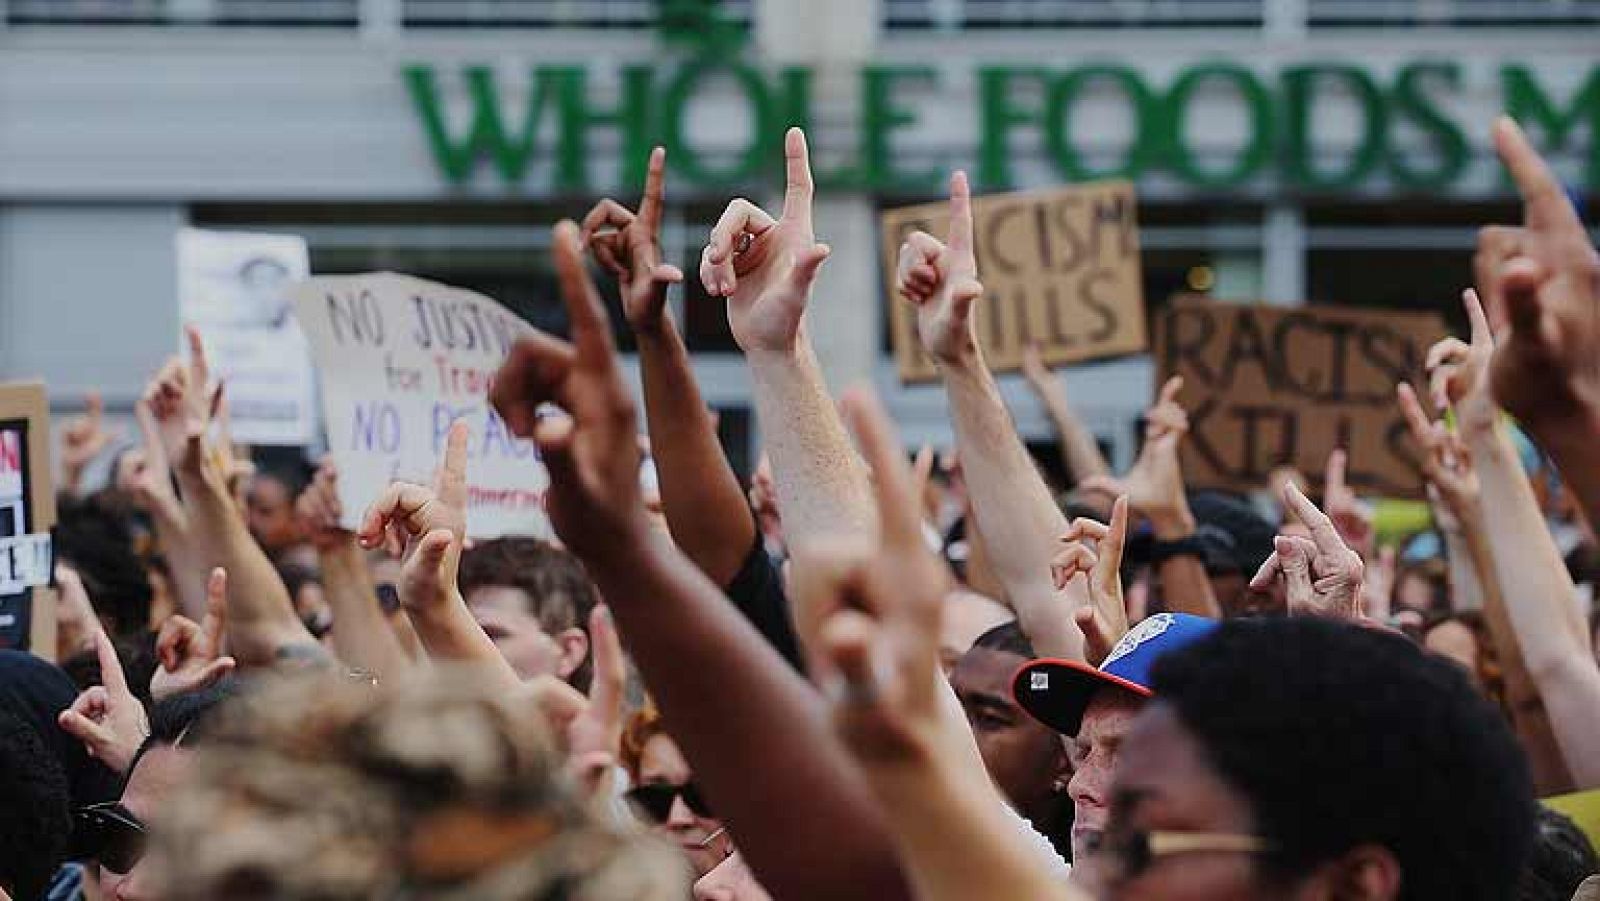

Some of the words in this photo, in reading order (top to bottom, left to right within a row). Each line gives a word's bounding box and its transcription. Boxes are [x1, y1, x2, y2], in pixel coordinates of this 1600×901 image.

[402, 62, 945, 190] WHOLE
[977, 62, 1470, 188] FOODS
[899, 192, 1135, 278] CISM
[326, 290, 384, 346] NO
[352, 403, 400, 452] NO
